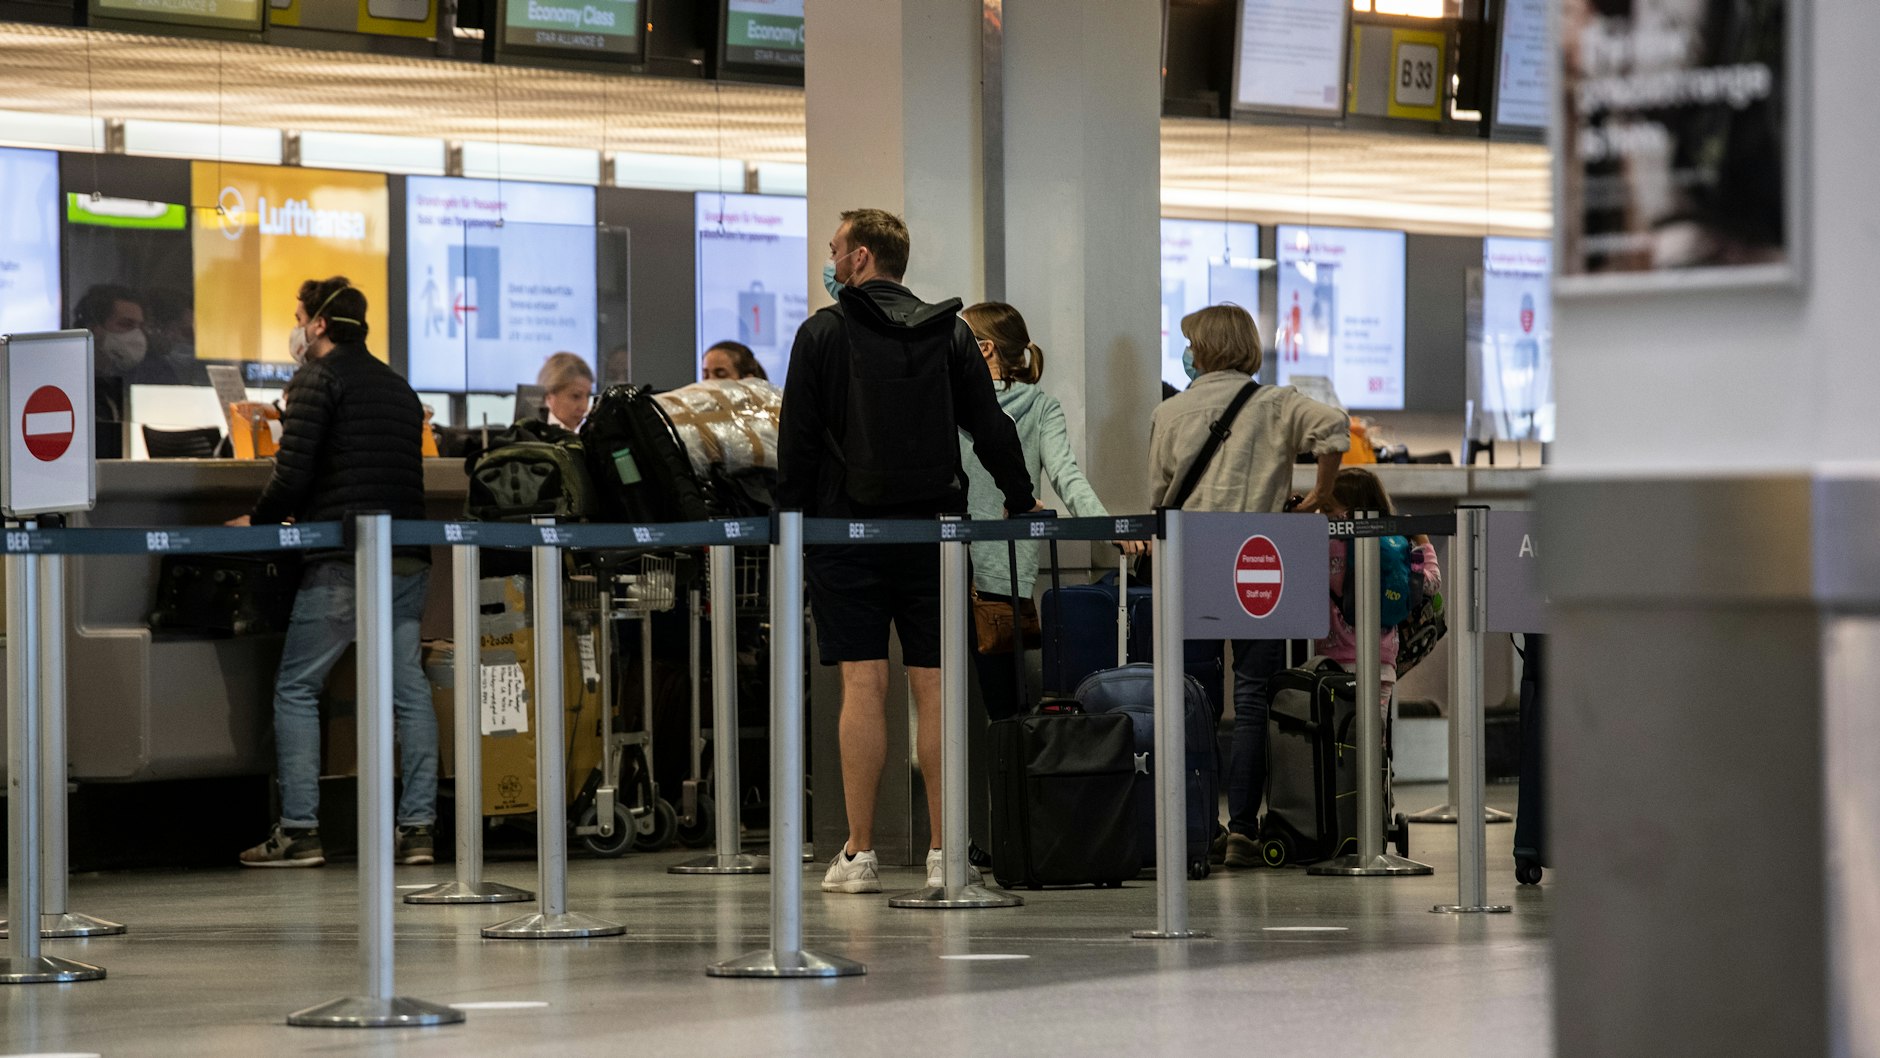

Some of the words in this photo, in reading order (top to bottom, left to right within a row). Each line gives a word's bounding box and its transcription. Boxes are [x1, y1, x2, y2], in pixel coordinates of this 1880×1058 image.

[528, 0, 582, 27] Economy
[583, 5, 615, 27] Class
[748, 19, 798, 46] Economy
[1402, 60, 1412, 87] B
[1416, 61, 1432, 90] 33
[258, 197, 365, 240] Lufthansa
[444, 524, 463, 541] BER
[724, 522, 741, 538] BER
[849, 523, 865, 538] BER
[941, 524, 956, 538] BER
[1030, 522, 1045, 536] BER
[1115, 519, 1129, 533] BER
[1328, 522, 1355, 535] BER
[7, 532, 30, 551] BER
[147, 532, 169, 550] BER
[279, 528, 302, 546] BER
[540, 527, 560, 543] BER
[633, 527, 652, 542] BER
[1242, 555, 1265, 563] Personal
[1246, 590, 1259, 598] Staff
